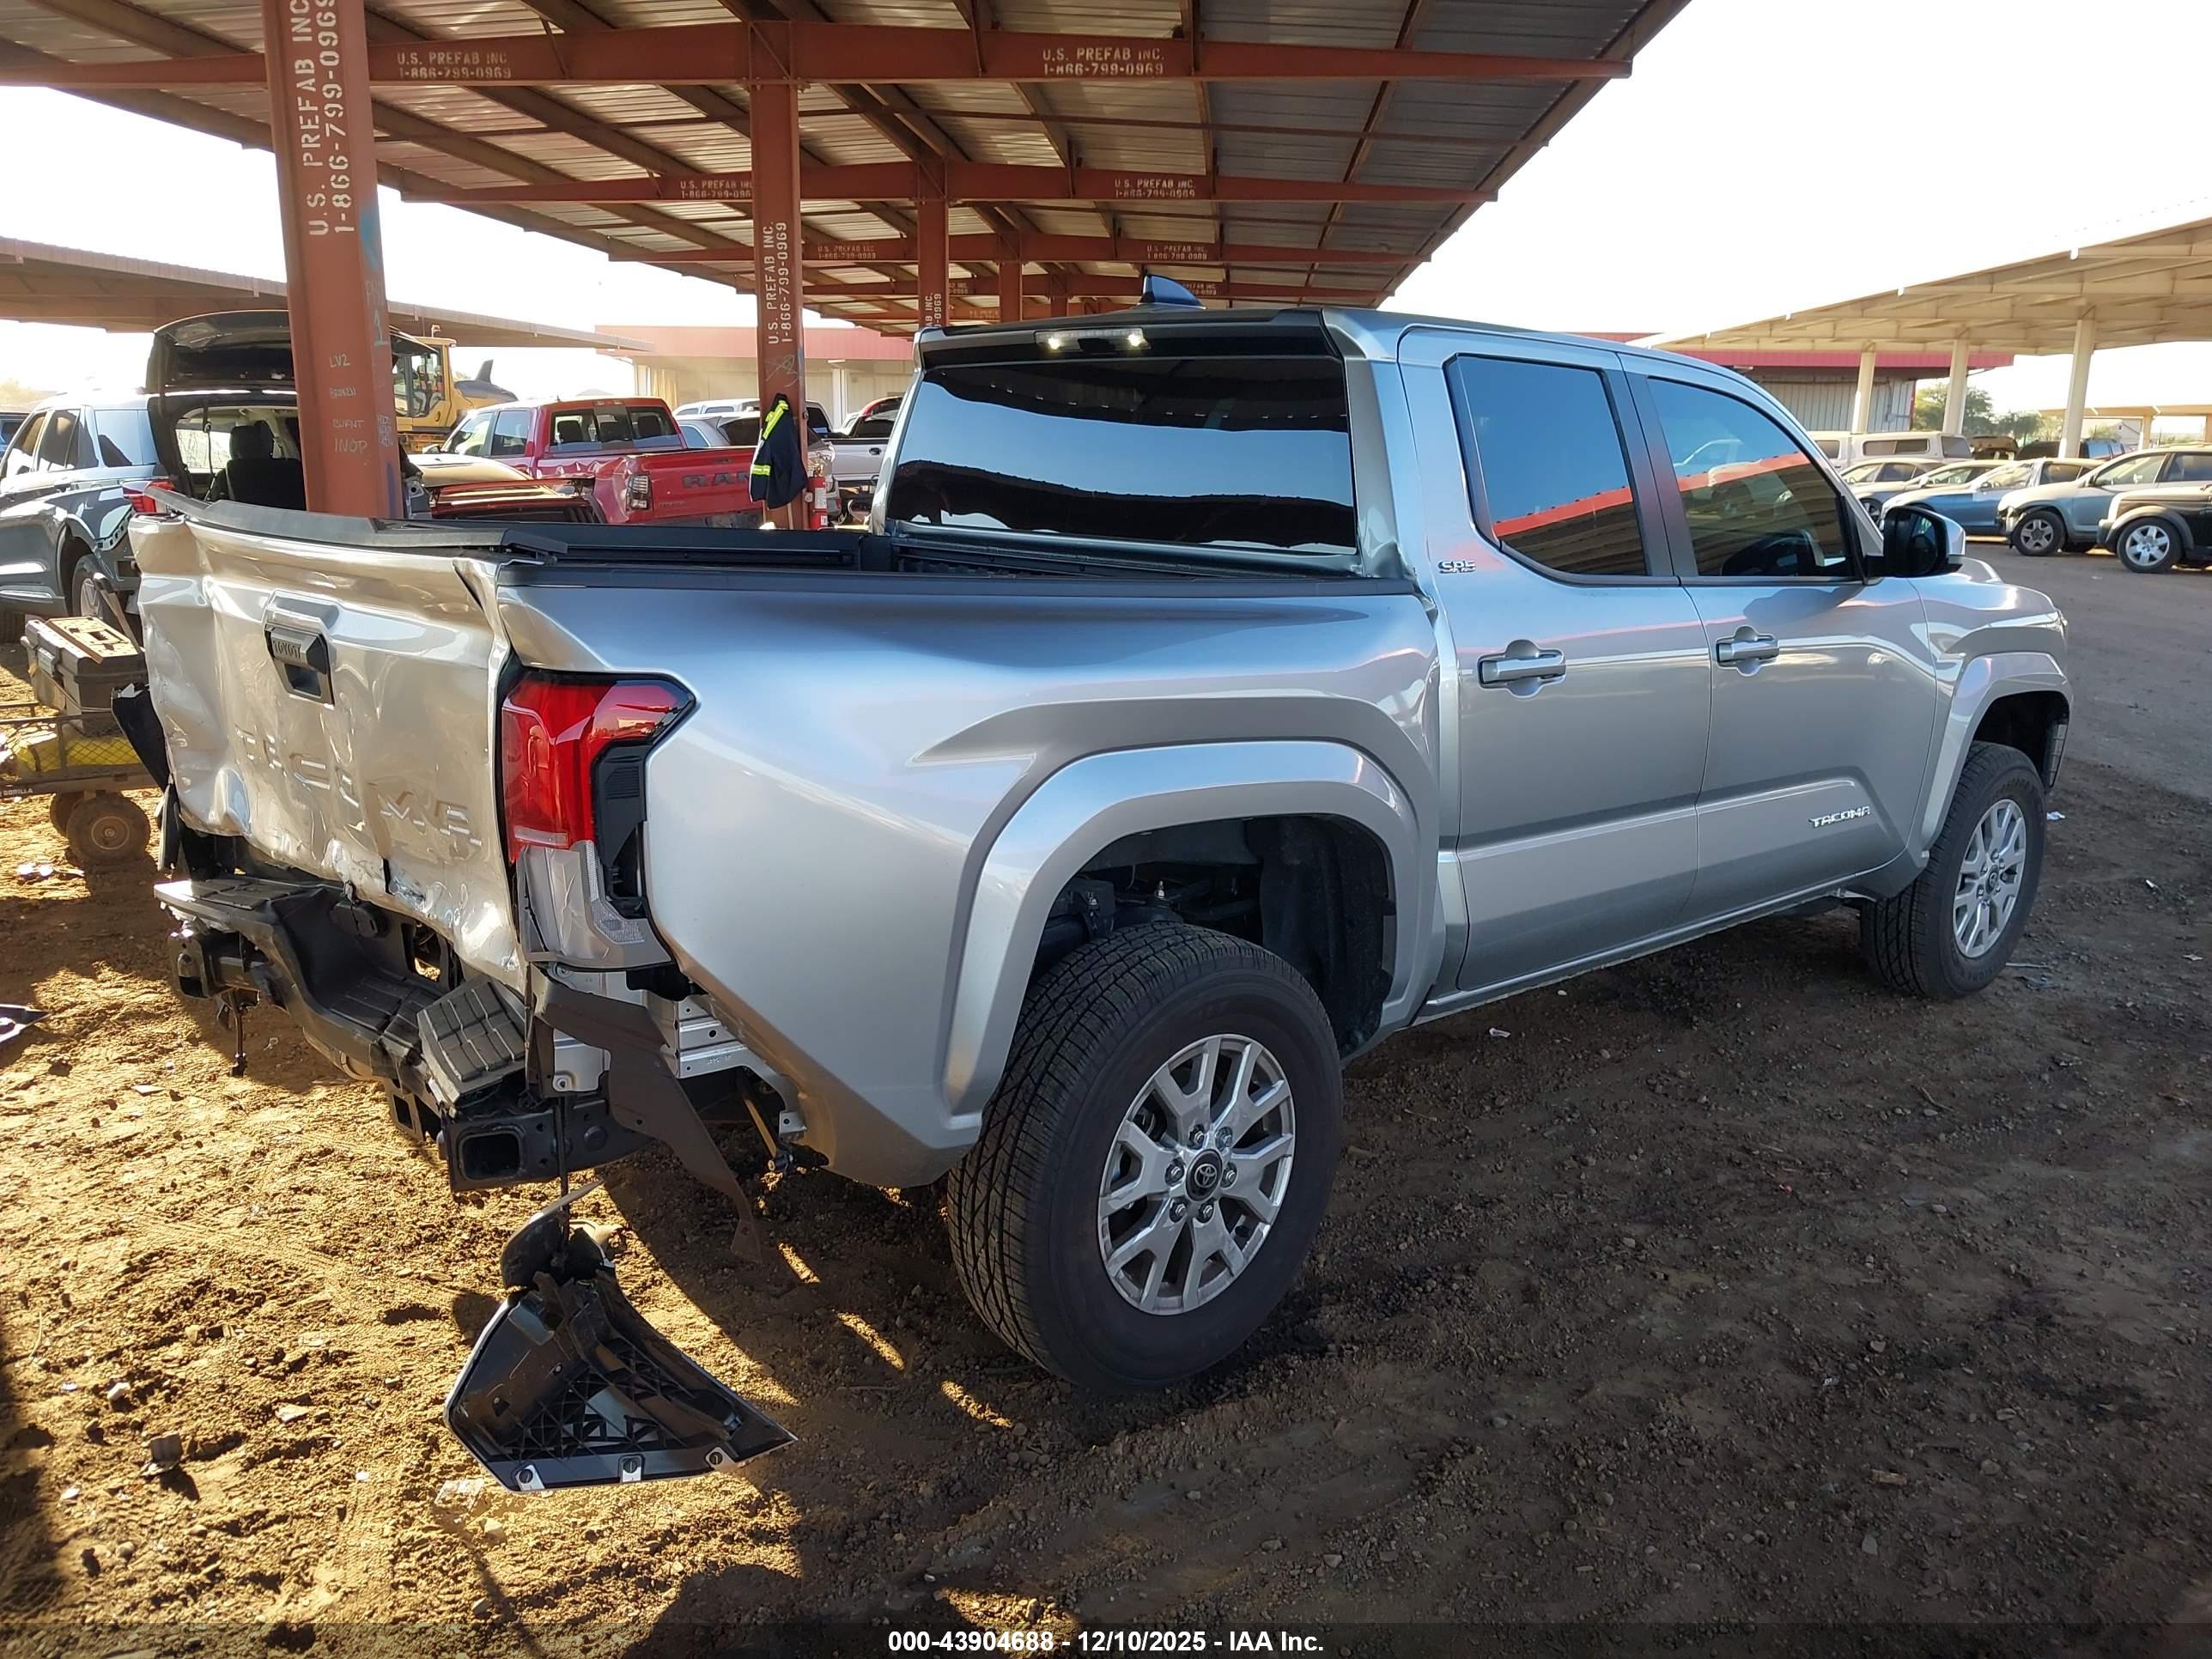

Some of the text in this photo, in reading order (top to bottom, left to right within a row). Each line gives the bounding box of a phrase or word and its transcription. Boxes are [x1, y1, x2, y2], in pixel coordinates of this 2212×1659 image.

[397, 52, 422, 65] U.S.
[428, 52, 480, 65] PREFAB
[1042, 47, 1164, 62] U.S. PREFAB INC.
[398, 67, 512, 79] 1-866-799-0969
[1043, 63, 1164, 76] 1-866-799-0969
[295, 58, 323, 167] PREFAB
[702, 179, 737, 189] PREFAB
[1137, 179, 1174, 189] PREFAB
[307, 184, 329, 235] U.S.
[763, 221, 780, 344] U.S. PREFAB INC.
[775, 222, 793, 343] 1-866-799-0969
[1808, 805, 1870, 829] TACOMA
